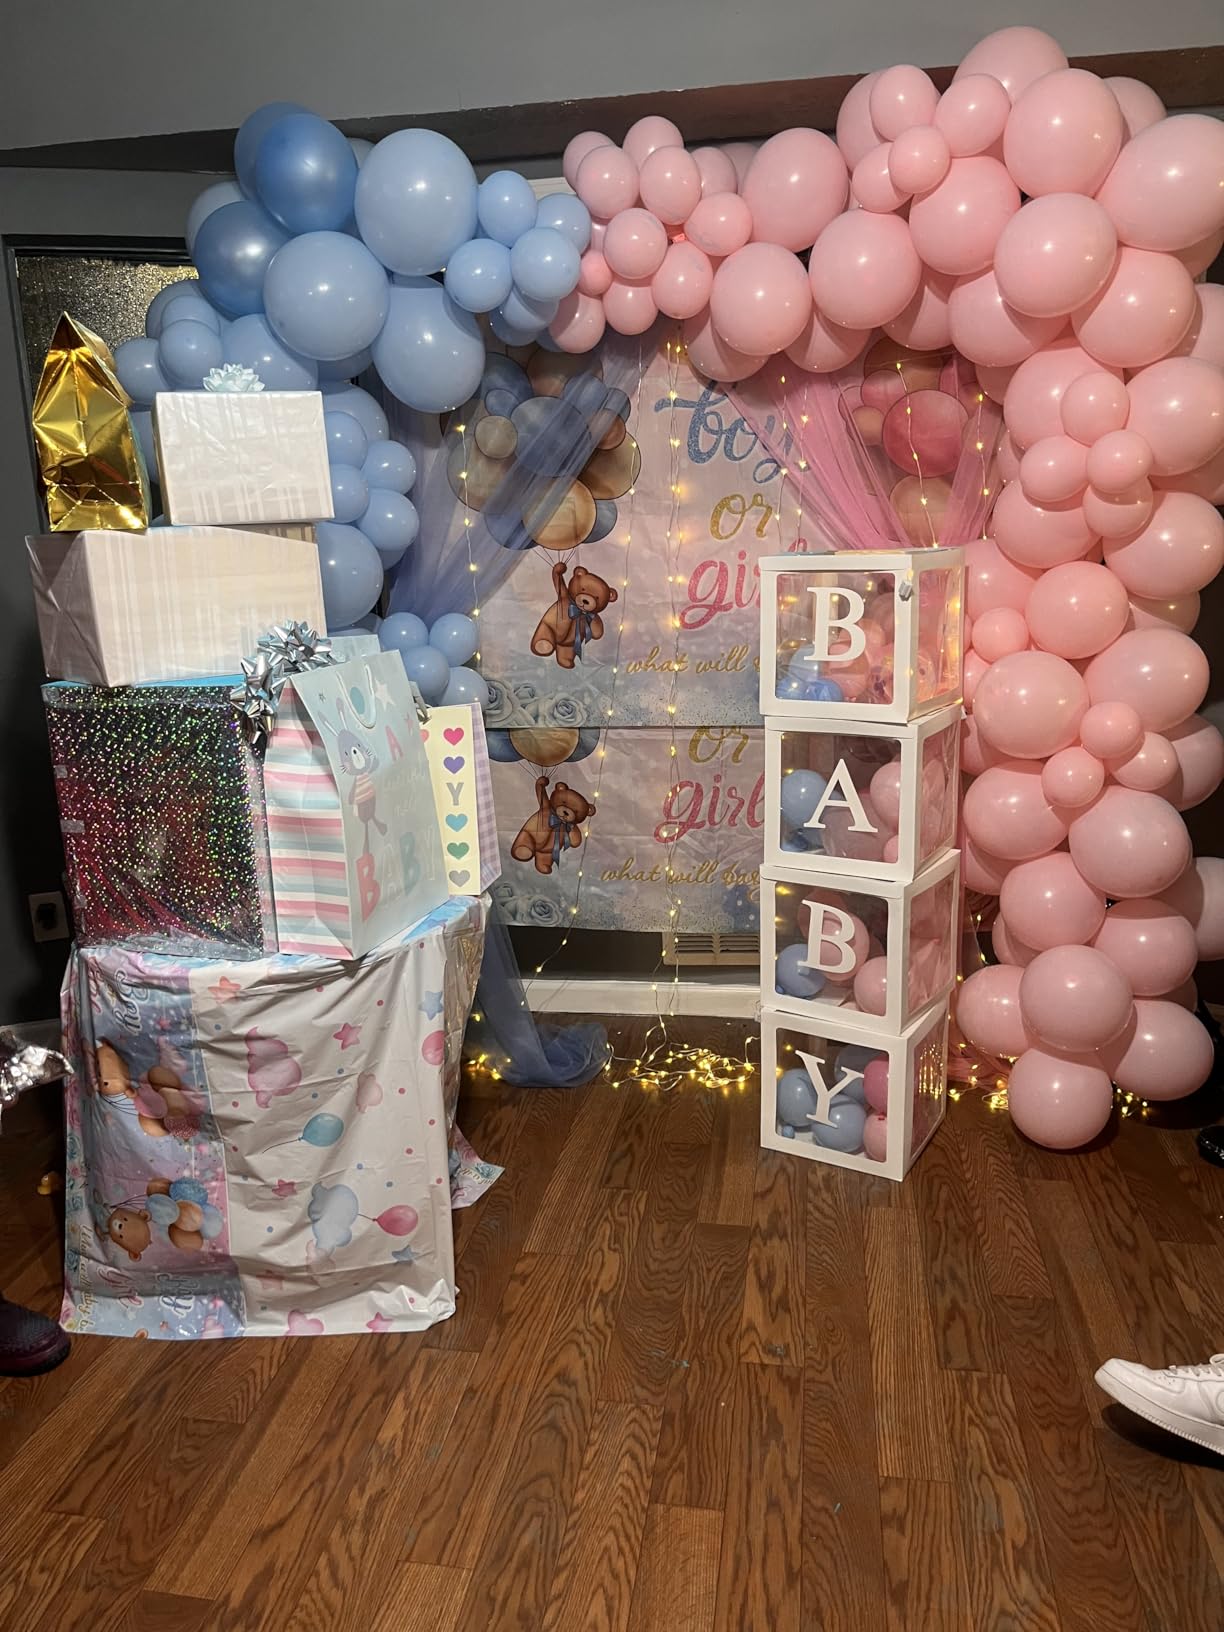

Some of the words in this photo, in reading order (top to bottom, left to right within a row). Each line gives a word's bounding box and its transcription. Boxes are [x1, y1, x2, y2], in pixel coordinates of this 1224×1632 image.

[710, 493, 772, 541] or
[804, 587, 867, 661] B
[626, 646, 688, 673] what
[696, 644, 749, 673] will
[688, 726, 749, 763] or
[446, 782, 464, 806] Y
[803, 758, 878, 833] A
[601, 857, 661, 882] what
[668, 860, 719, 884] will
[798, 899, 857, 974] B
[795, 1050, 865, 1128] Y
